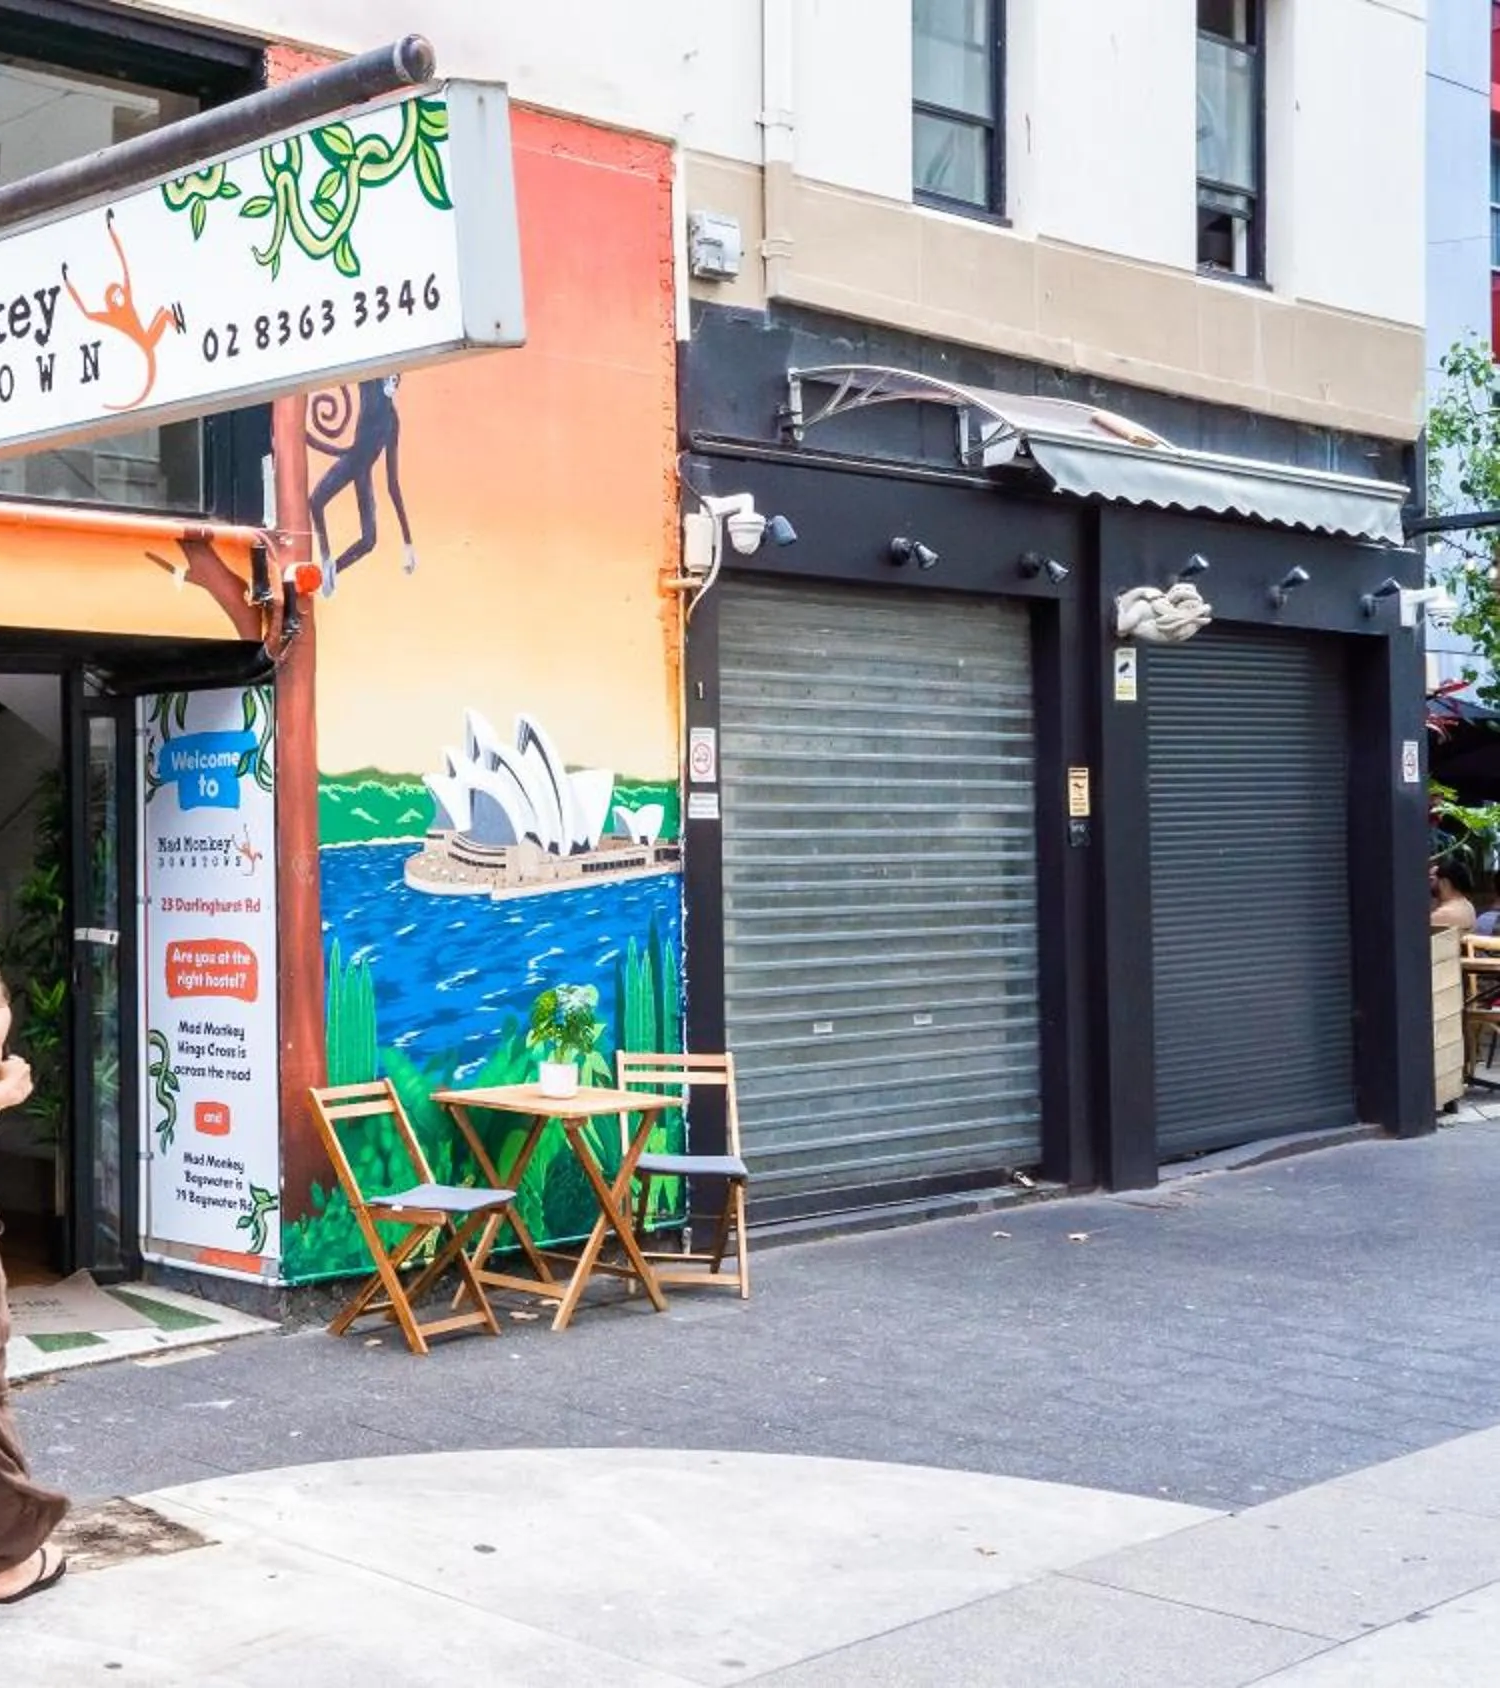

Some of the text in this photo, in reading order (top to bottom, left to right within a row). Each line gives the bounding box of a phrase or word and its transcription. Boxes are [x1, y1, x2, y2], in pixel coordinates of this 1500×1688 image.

[202, 272, 441, 363] 02 8363 3346
[171, 750, 240, 771] Welcome
[198, 774, 219, 799] to
[157, 836, 231, 854] Mad Monkey
[161, 898, 261, 917] 23 Darlinghurst Rd
[172, 948, 251, 968] Are you at the
[177, 971, 247, 990] right hostel?
[178, 1020, 245, 1041] Mad Monkey
[178, 1040, 247, 1059] Kings Cross is
[174, 1065, 251, 1081] across the road
[203, 1110, 222, 1124] and
[183, 1152, 245, 1175] Mad Monkey
